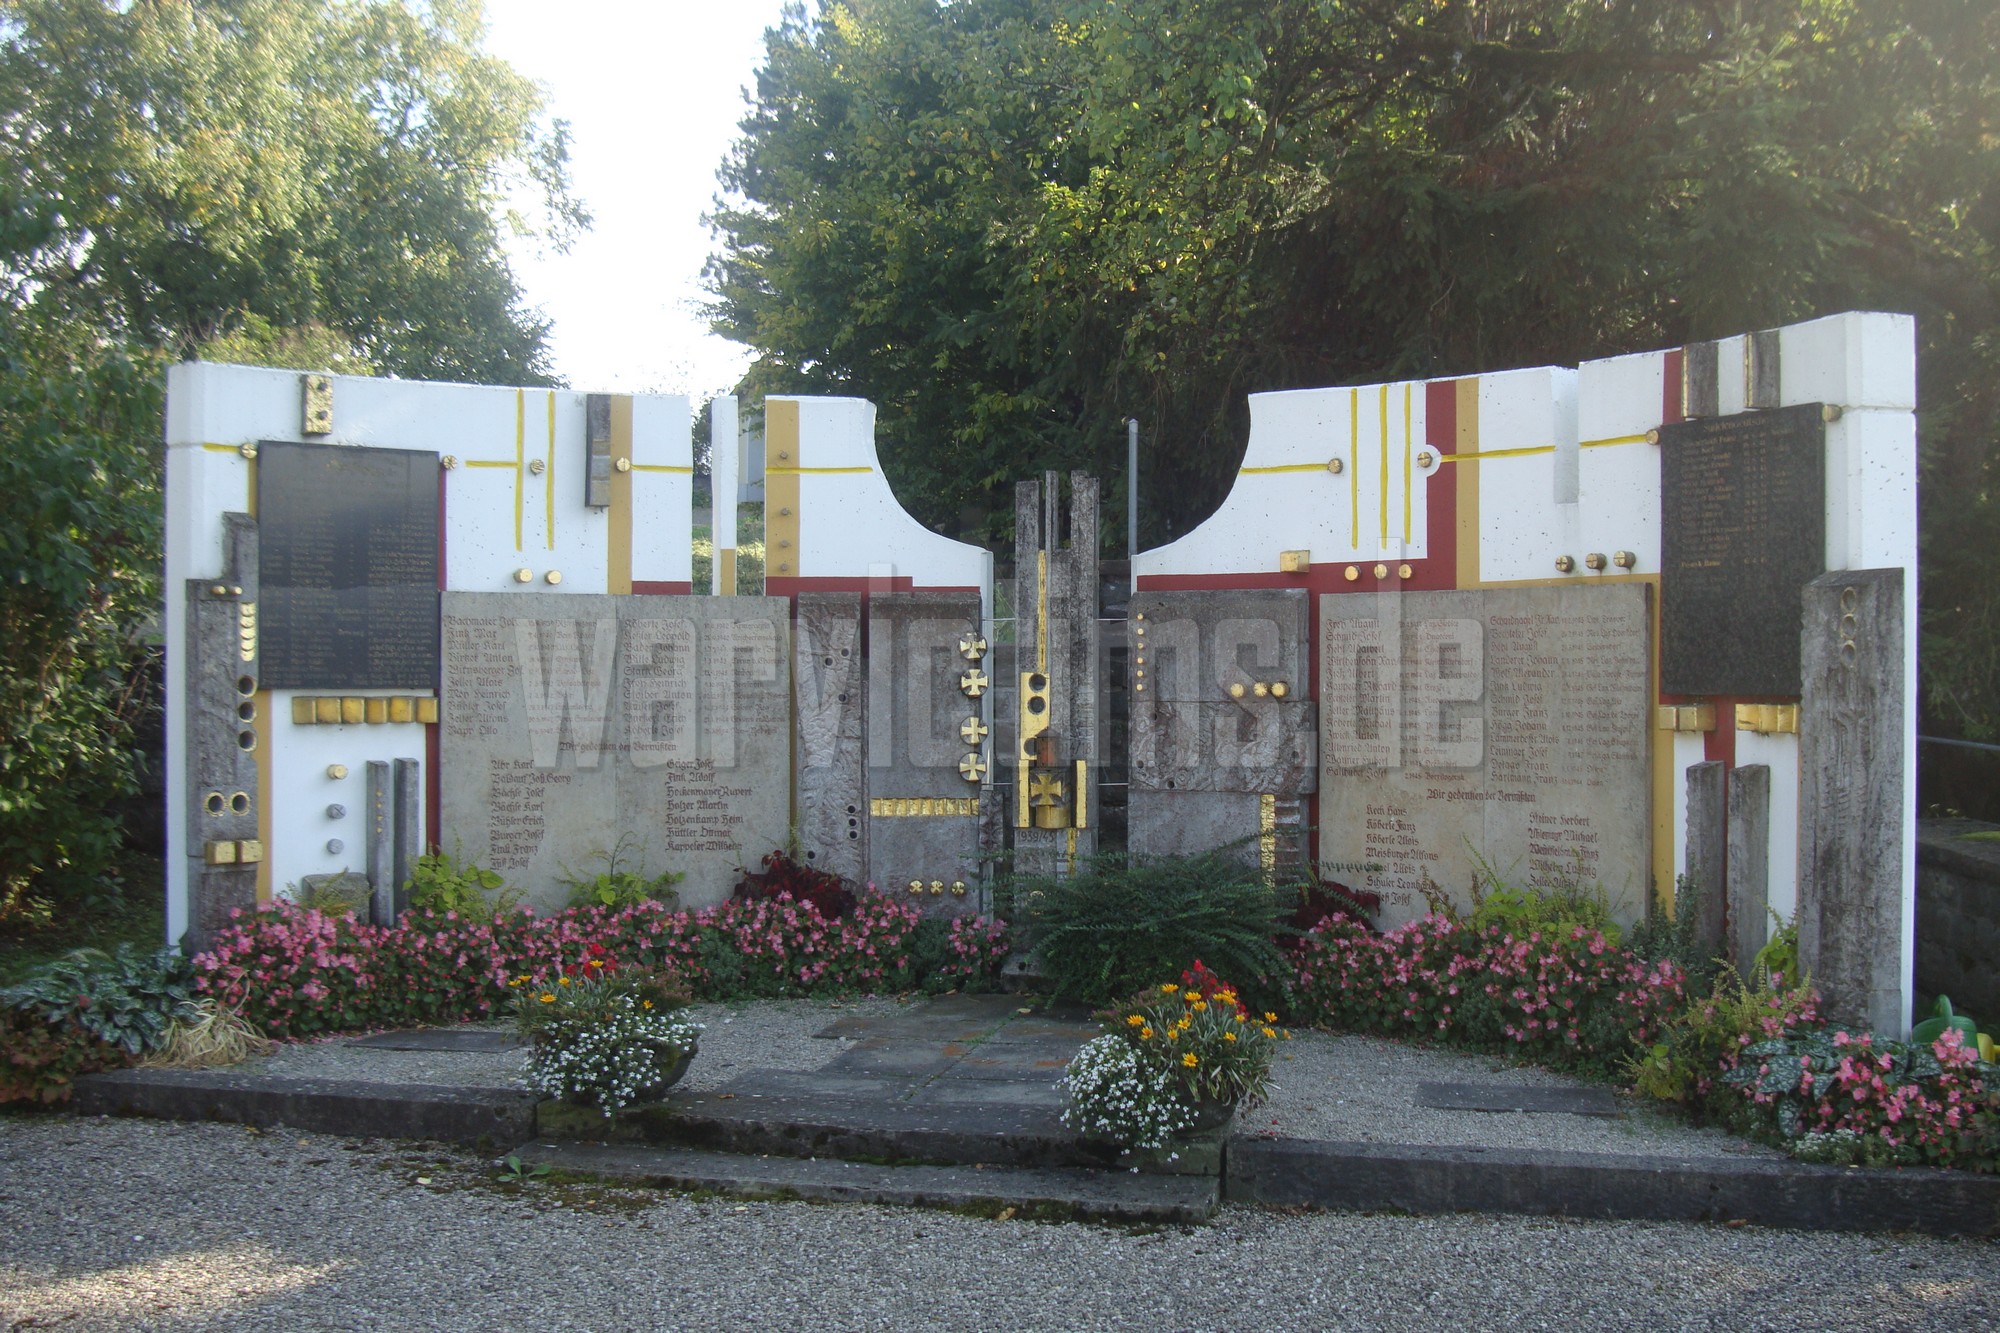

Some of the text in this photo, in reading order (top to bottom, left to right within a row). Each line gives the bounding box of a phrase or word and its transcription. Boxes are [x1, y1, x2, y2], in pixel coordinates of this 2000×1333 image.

[559, 742, 578, 752] Wir
[580, 742, 617, 753] gedenken
[618, 742, 631, 752] der
[1426, 789, 1445, 800] Wir
[1447, 789, 1484, 801] gedenken
[1018, 831, 1055, 843] 1939/45
